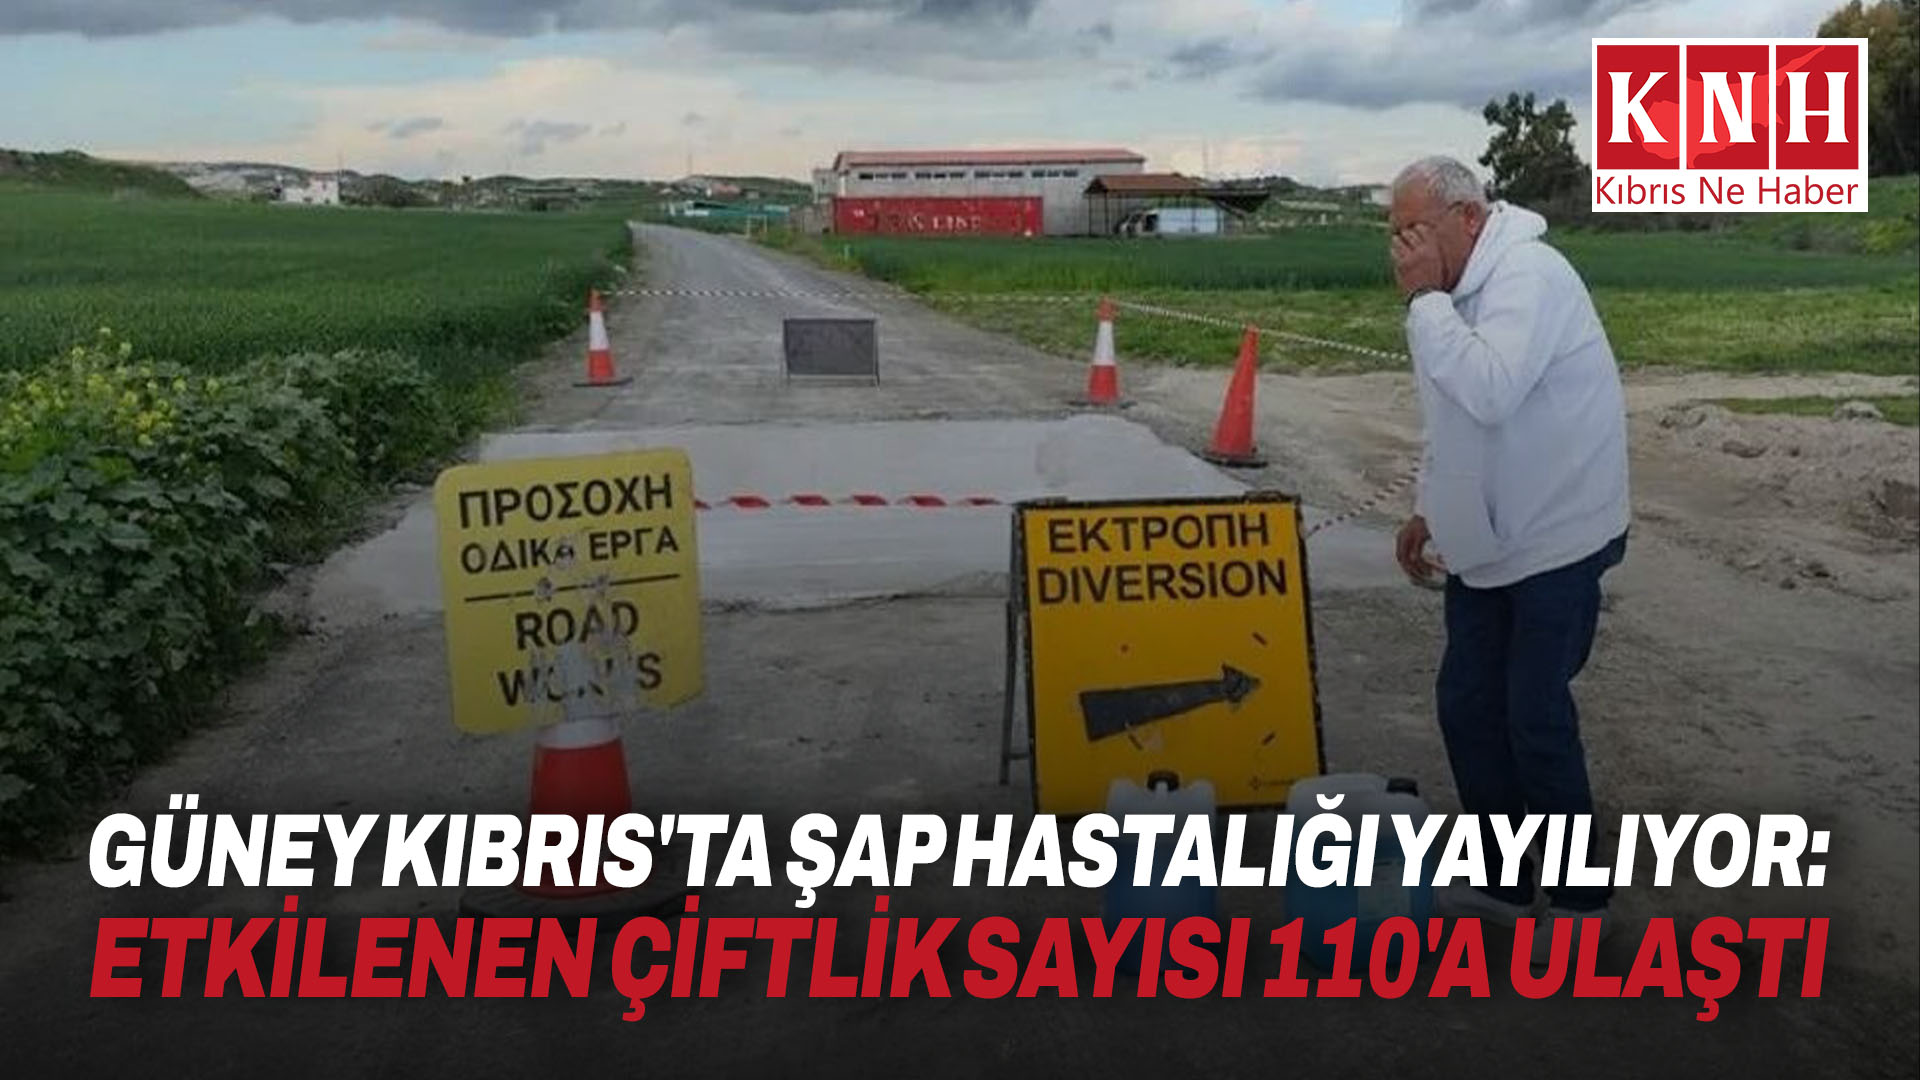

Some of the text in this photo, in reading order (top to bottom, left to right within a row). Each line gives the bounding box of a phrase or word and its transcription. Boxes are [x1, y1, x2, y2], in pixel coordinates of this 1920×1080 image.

[458, 473, 673, 529] ΠΡΟΣΟΧΗ
[588, 525, 680, 561] ΕΡΓΑ
[1047, 511, 1270, 554] ΕΚΤΡΟΠΗ
[1037, 559, 1288, 605] DIVERSION
[515, 601, 640, 651] ROAD
